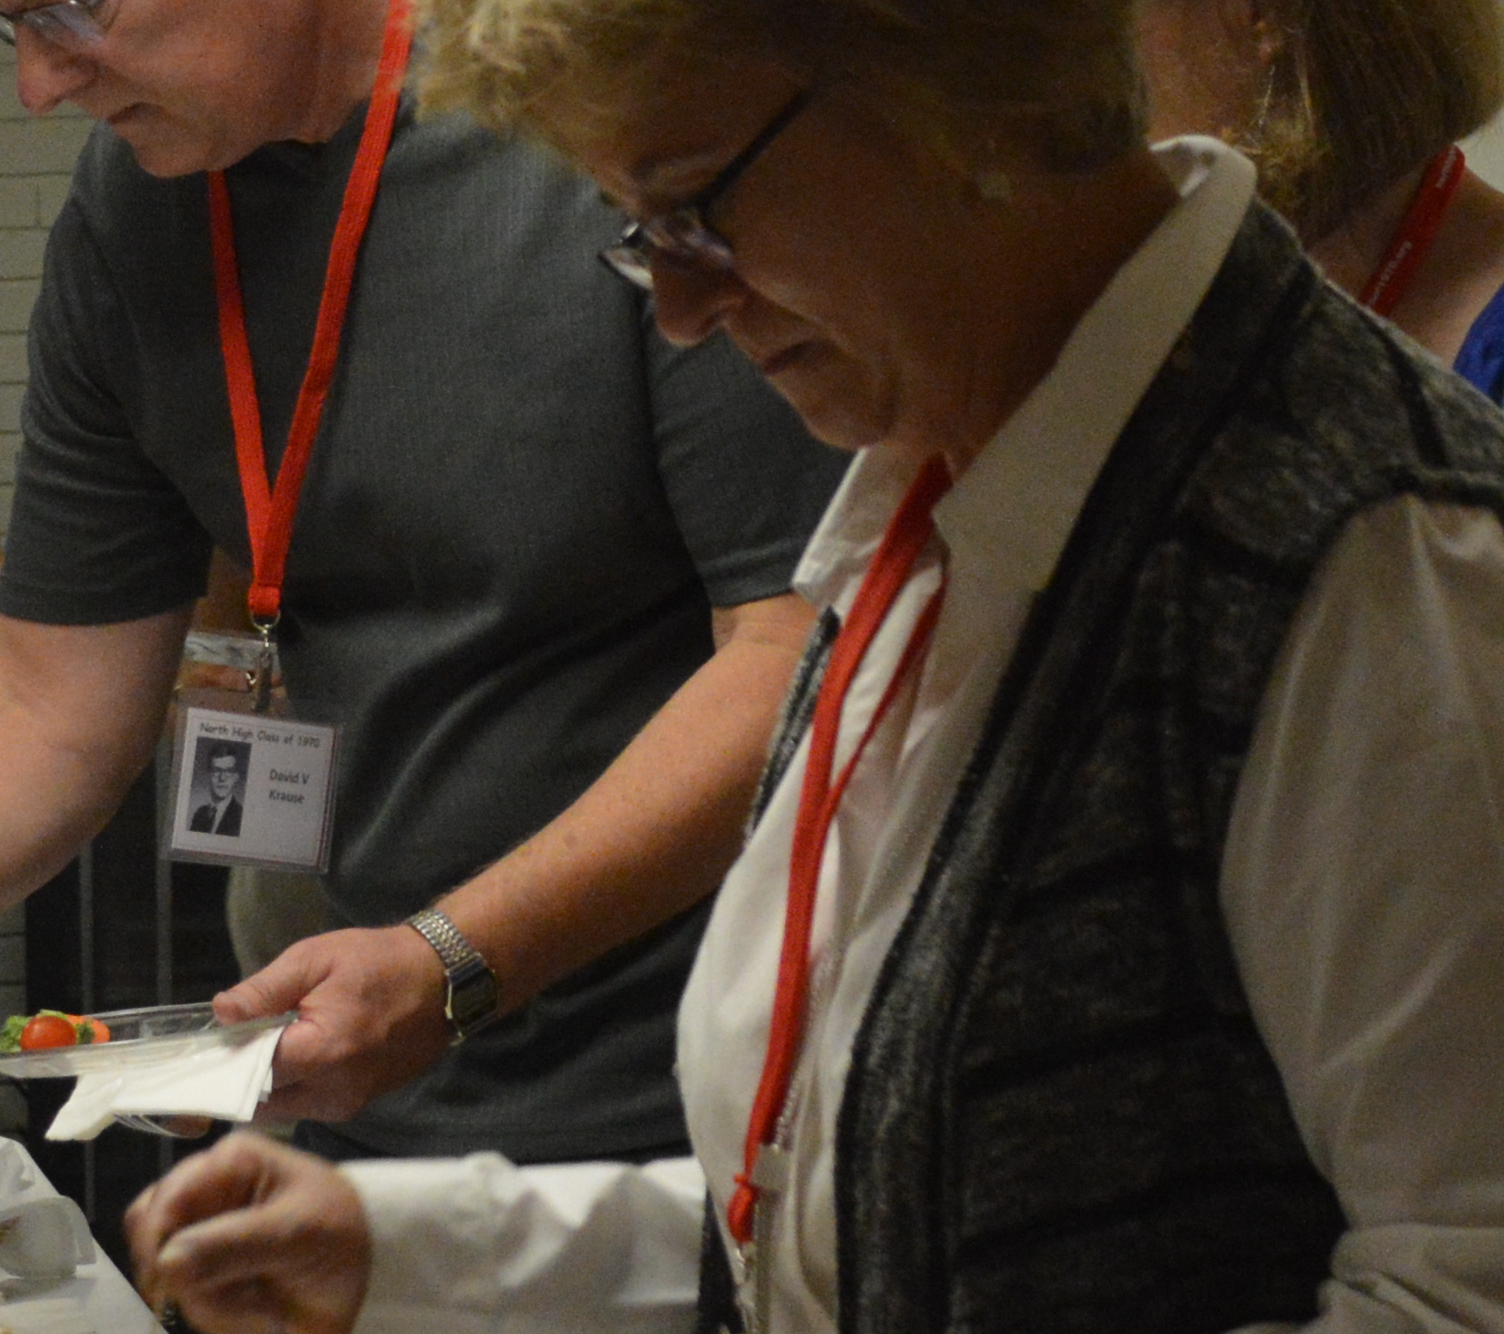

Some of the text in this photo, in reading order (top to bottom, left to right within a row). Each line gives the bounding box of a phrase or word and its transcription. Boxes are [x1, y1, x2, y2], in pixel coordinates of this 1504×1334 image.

[200, 723, 229, 735] North
[232, 728, 253, 741] High
[257, 730, 280, 743] Class
[298, 736, 320, 748] 1970
[269, 769, 310, 785] David V
[269, 789, 304, 804] Krause
